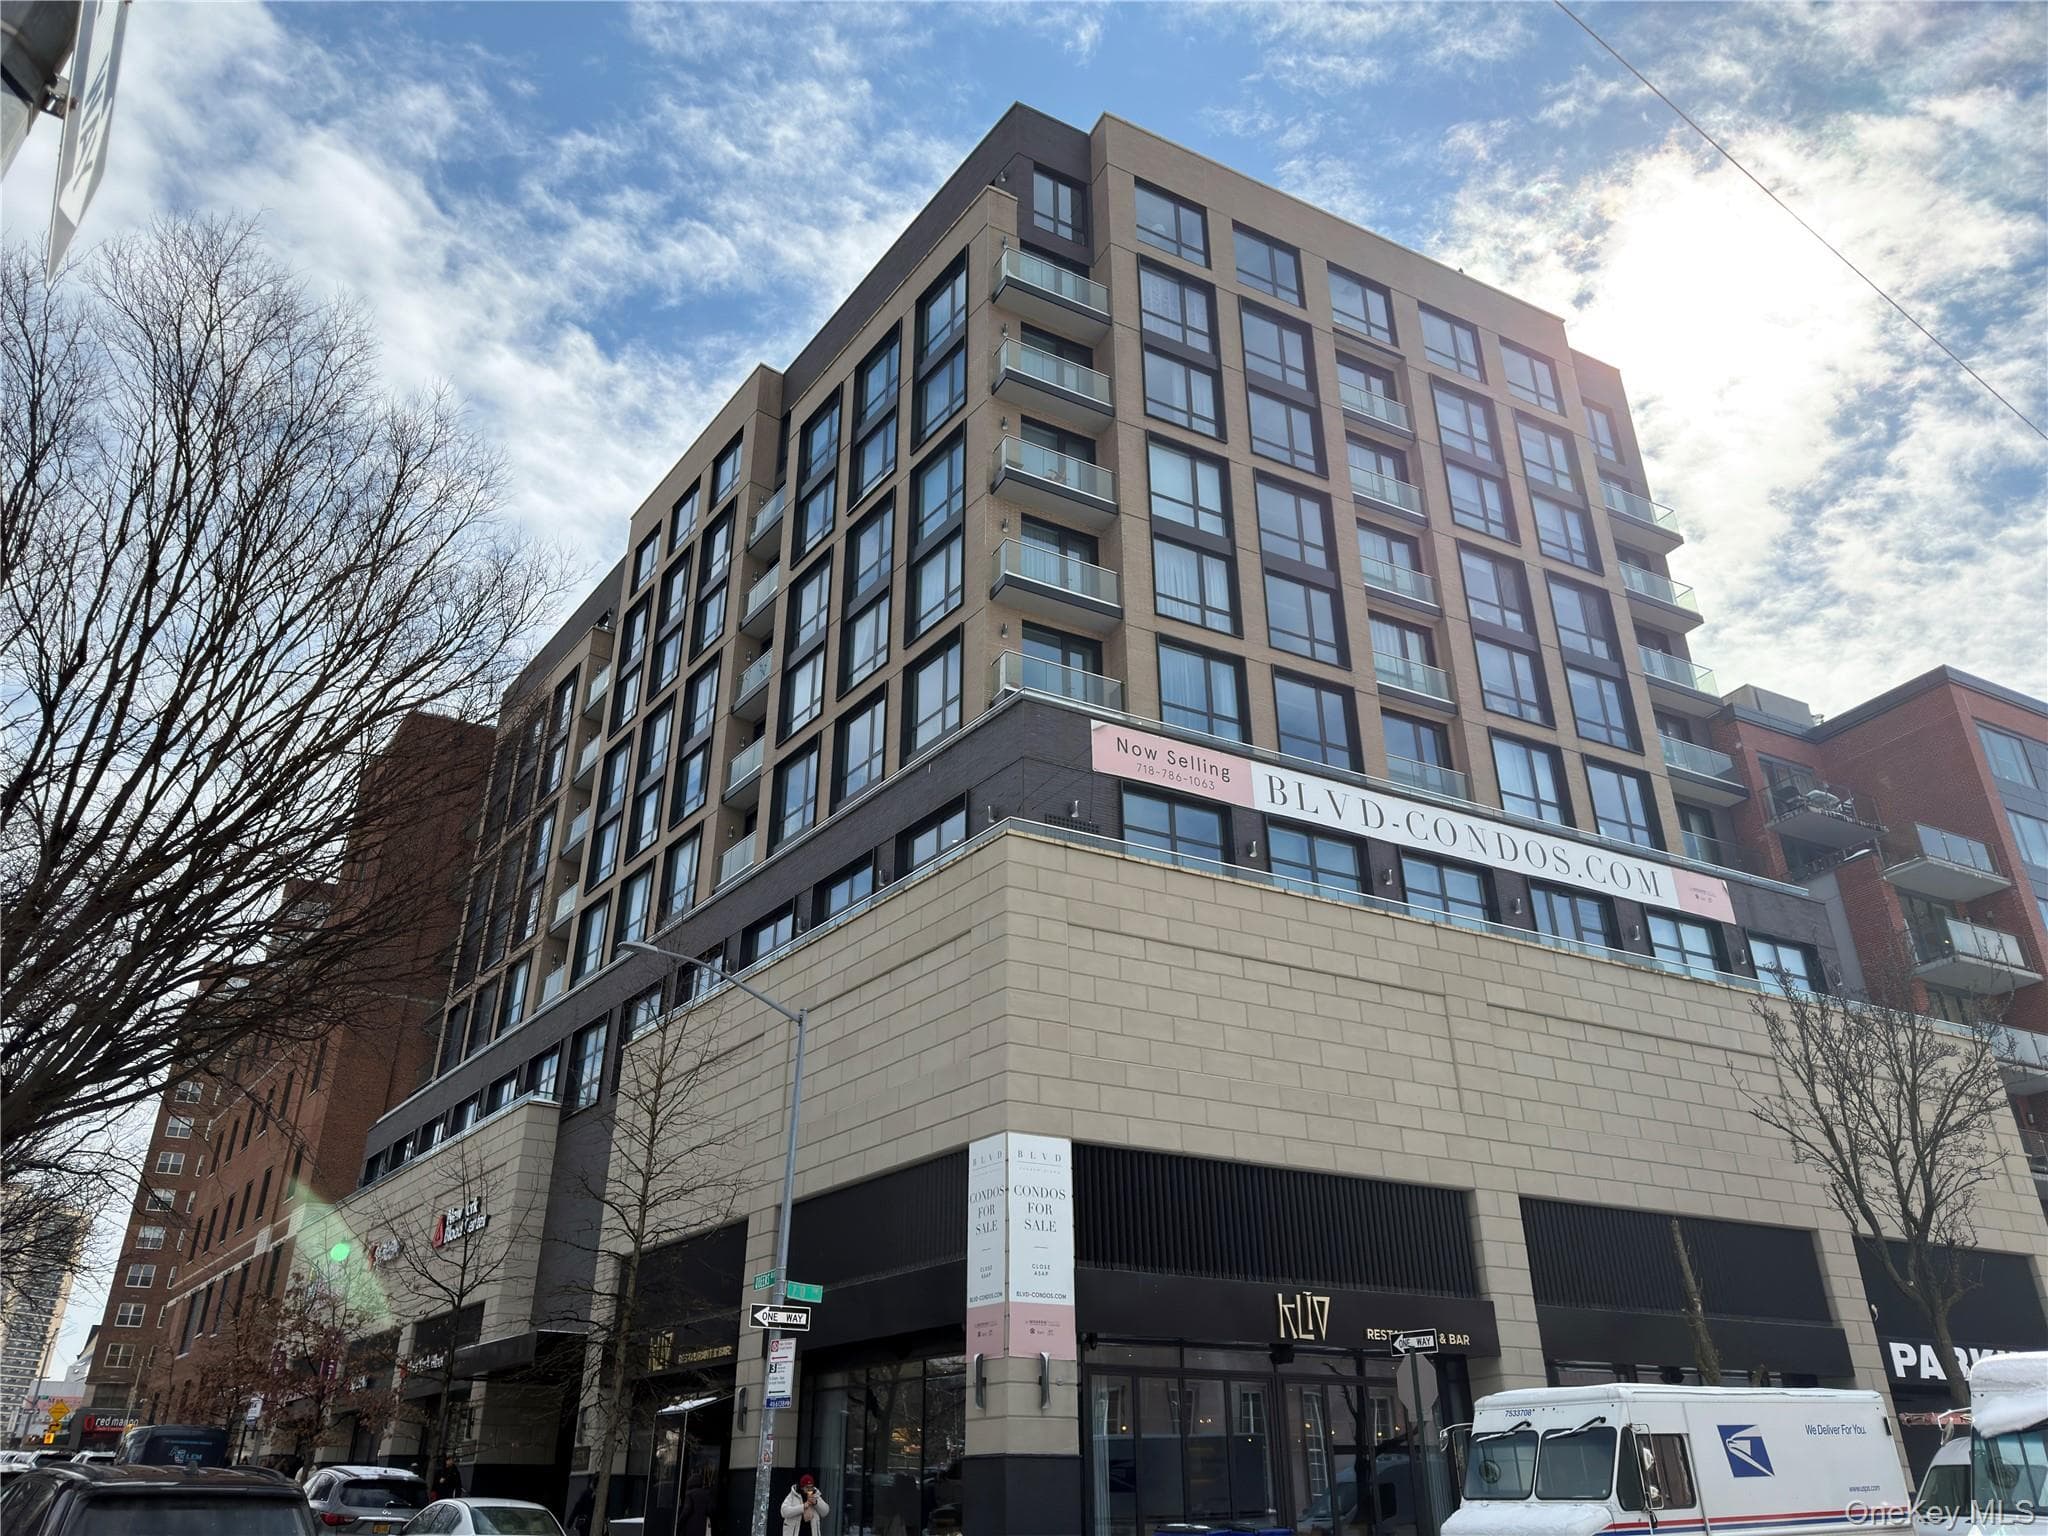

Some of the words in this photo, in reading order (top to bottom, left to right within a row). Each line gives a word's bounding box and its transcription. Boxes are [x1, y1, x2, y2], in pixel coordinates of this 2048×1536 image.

[73, 53, 109, 192] WAY
[1116, 737, 1158, 761] Now
[1167, 750, 1231, 783] Selling
[1136, 762, 1216, 791] 718-786-1063
[1265, 772, 1662, 899] BLVD-CONDOS.COM
[1017, 1150, 1062, 1162] BLVD
[970, 1184, 1004, 1204] CONDOS
[1013, 1184, 1066, 1200] CONDOS
[978, 1203, 995, 1219] FOR
[1027, 1202, 1053, 1216] FOR
[975, 1220, 998, 1236] SALE
[1024, 1219, 1057, 1233] SALE
[1016, 1291, 1067, 1299] BLVD-CONDOS.COM
[762, 1312, 778, 1322] ONE
[786, 1314, 803, 1323] WAY
[1417, 1337, 1431, 1346] WAY
[1439, 1333, 1447, 1344] &
[1449, 1334, 1470, 1345] BAR
[1505, 1409, 1531, 1417] 7533708
[1805, 1424, 1816, 1434] We
[1817, 1424, 1840, 1435] Deliver
[1841, 1424, 1851, 1434] For
